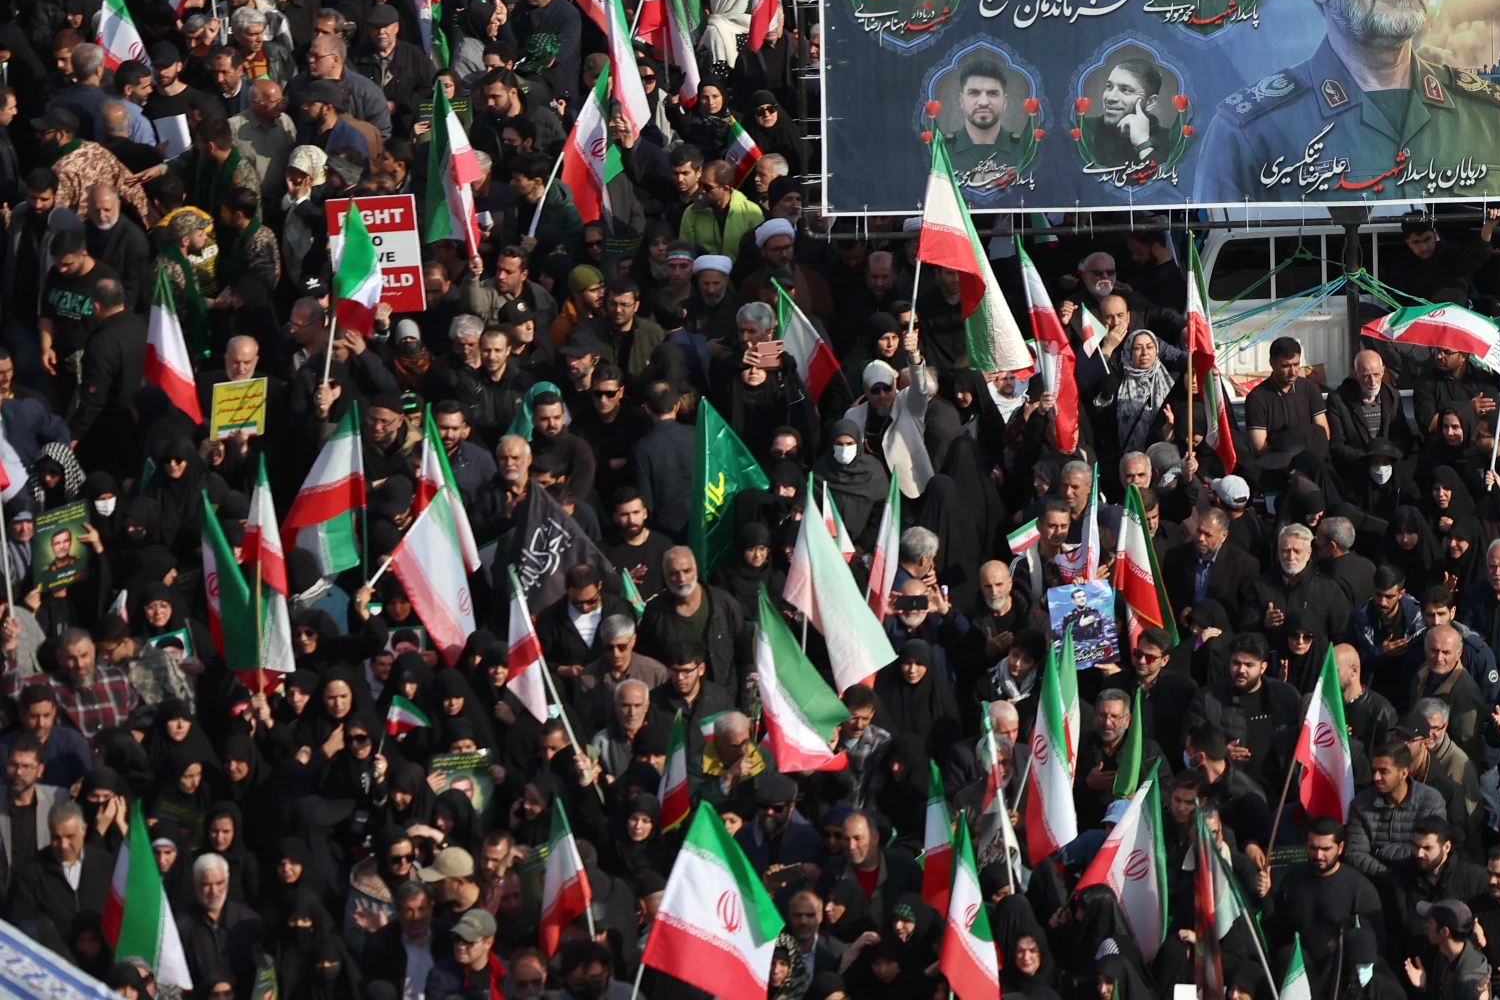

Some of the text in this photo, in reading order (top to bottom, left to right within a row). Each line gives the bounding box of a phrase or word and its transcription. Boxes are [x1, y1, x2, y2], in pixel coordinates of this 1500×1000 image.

[903, 6, 951, 32] شهید
[1230, 4, 1260, 28] پاسدار
[1260, 121, 1488, 194] دریابان پاسدار شهید علیرضا تنگسیری
[1010, 172, 1036, 191] پاسدار
[1115, 159, 1150, 187] مصطفی
[1131, 160, 1157, 184] شهید
[1152, 165, 1179, 185] پاسدار
[381, 273, 415, 288] RLD
